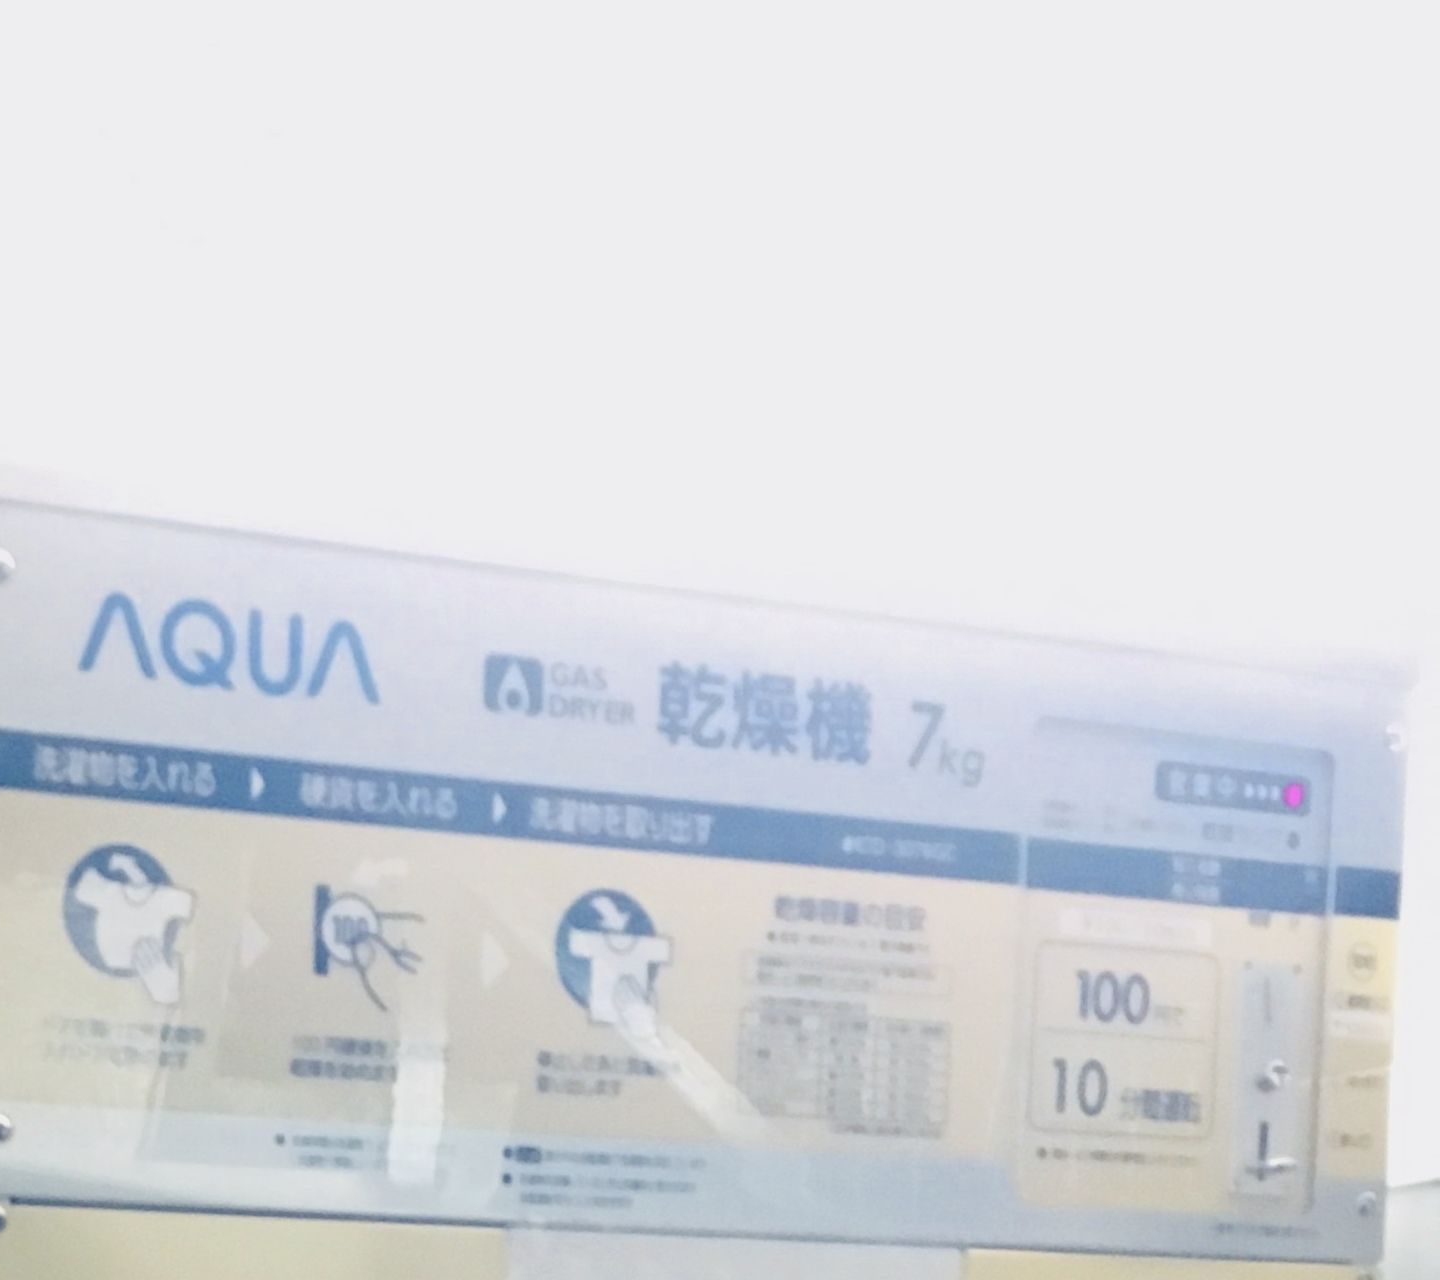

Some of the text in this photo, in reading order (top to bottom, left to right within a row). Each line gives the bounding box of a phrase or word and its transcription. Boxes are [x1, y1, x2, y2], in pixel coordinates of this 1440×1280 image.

[78, 592, 380, 704] AQUA
[549, 662, 609, 690] GAS
[548, 695, 635, 725] DRYER
[658, 662, 872, 764] 乾燥機
[1077, 969, 1151, 1024] 100
[1054, 1058, 1108, 1117] 10
